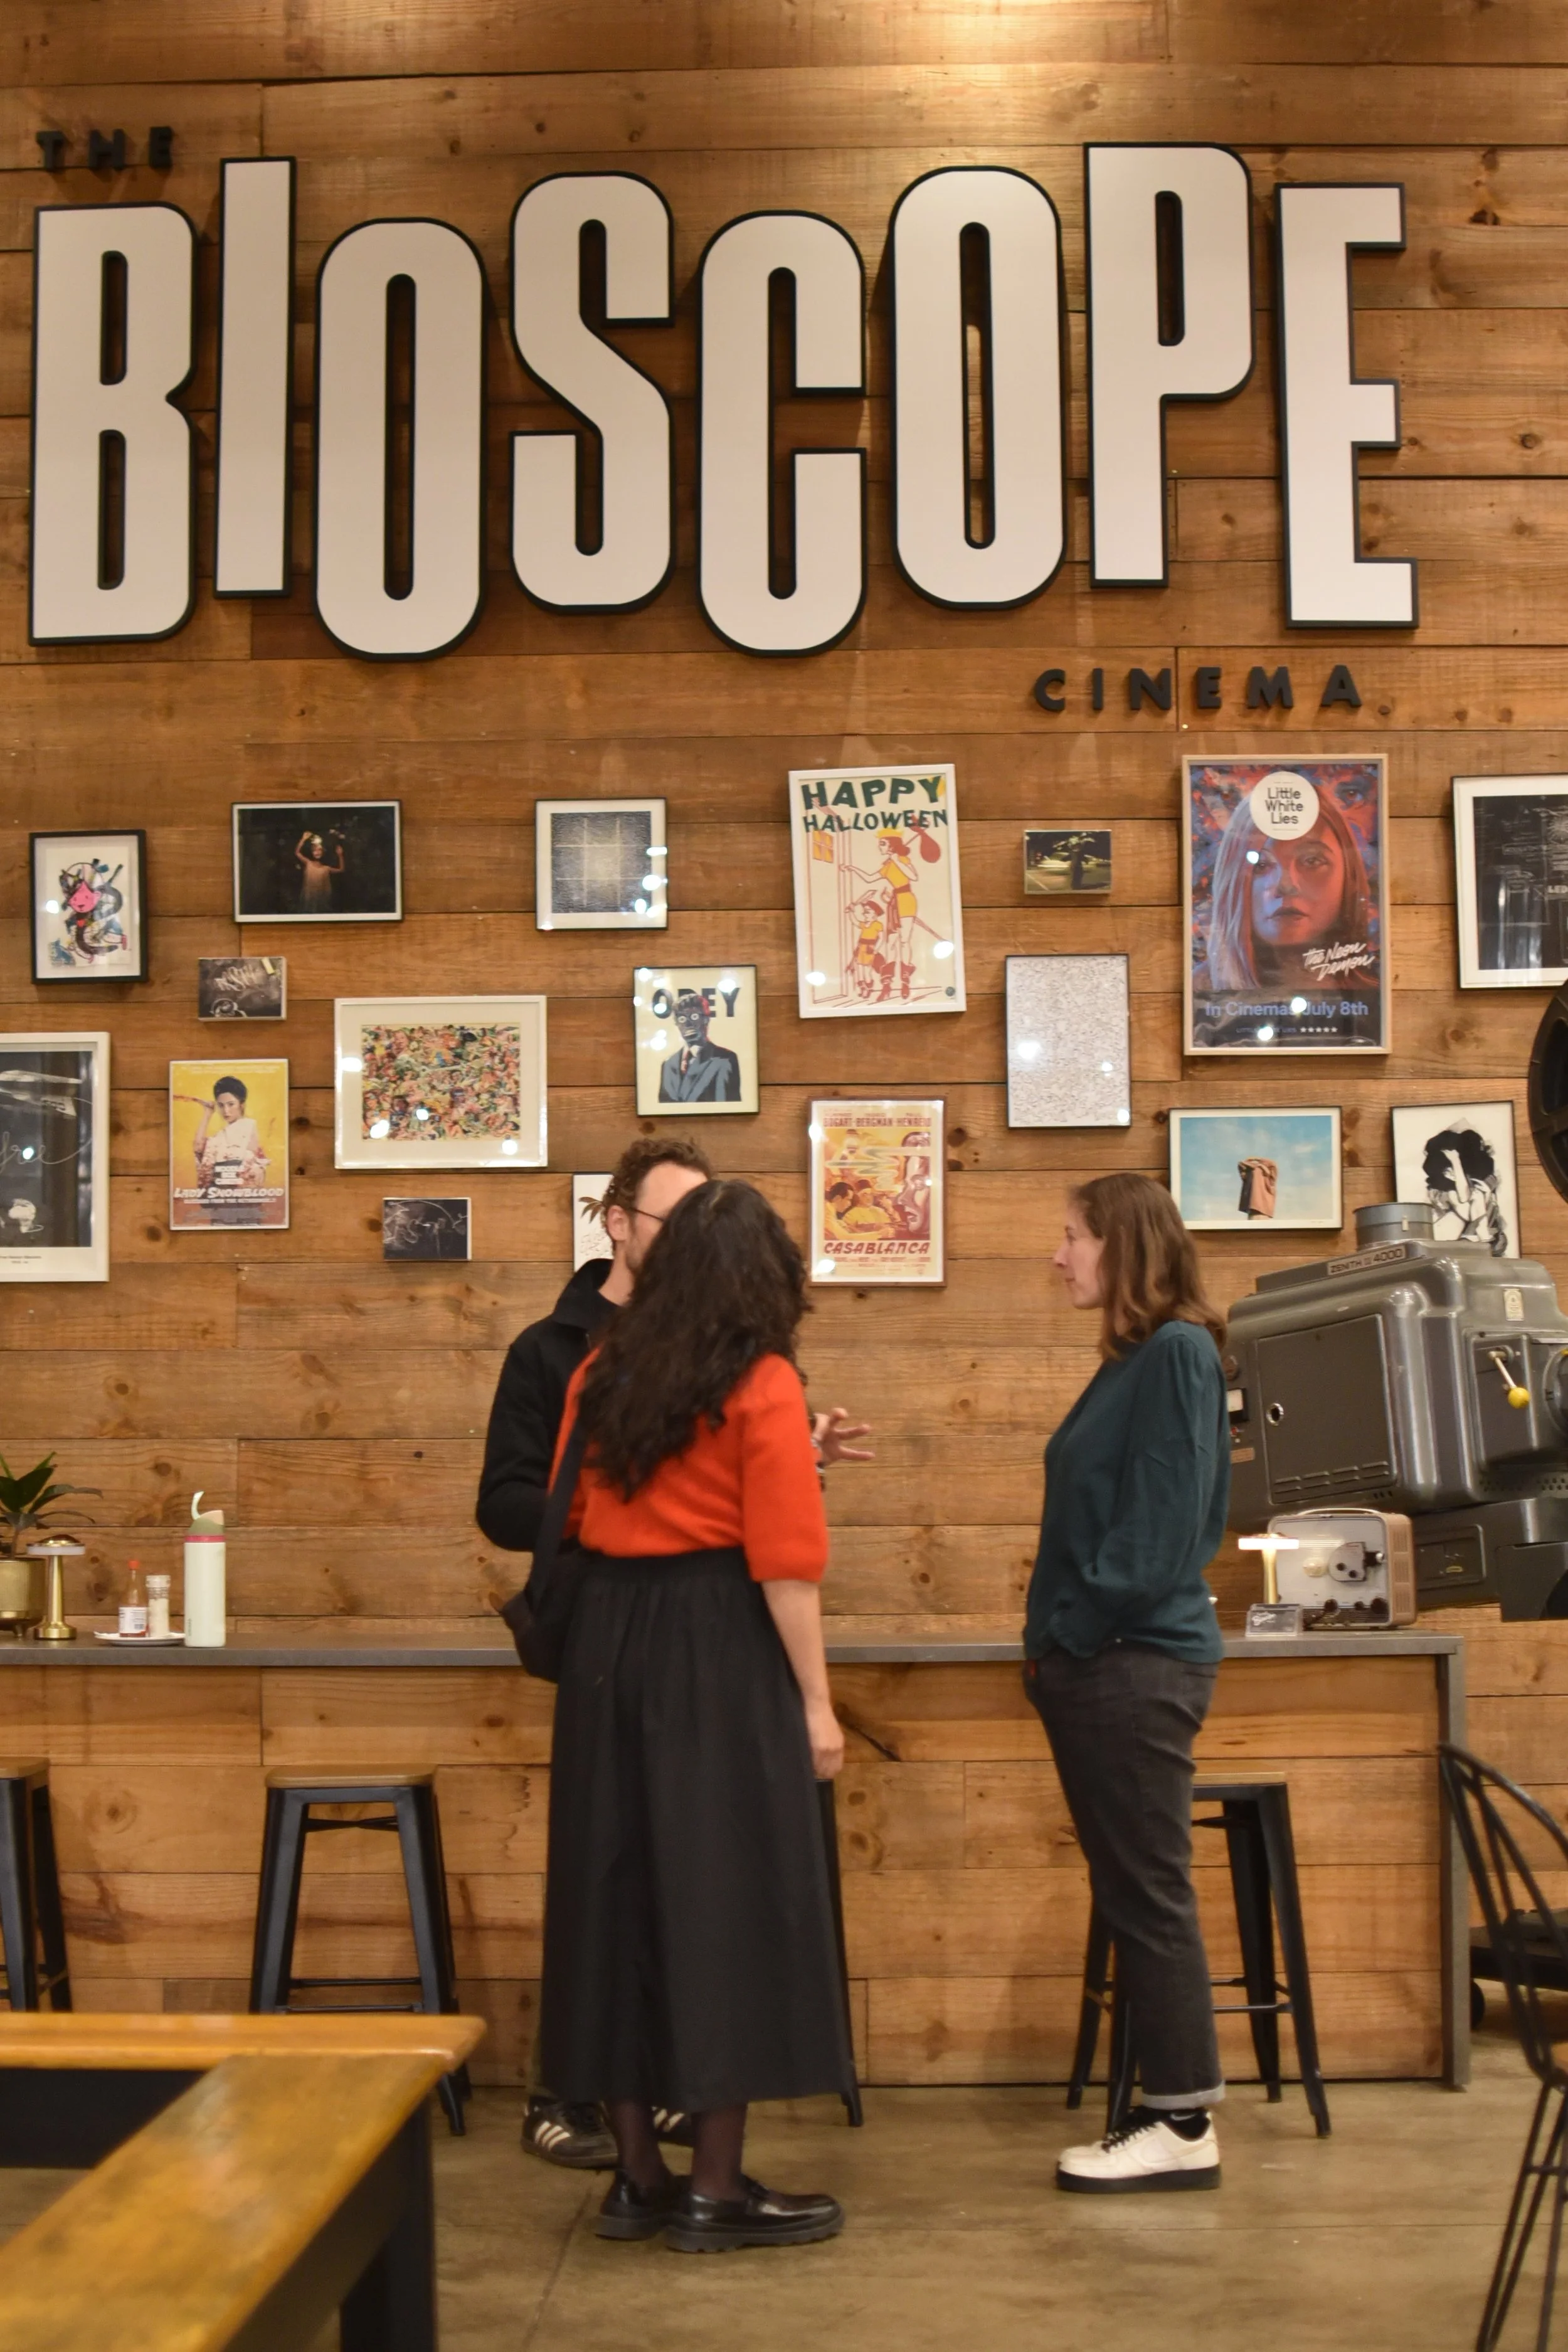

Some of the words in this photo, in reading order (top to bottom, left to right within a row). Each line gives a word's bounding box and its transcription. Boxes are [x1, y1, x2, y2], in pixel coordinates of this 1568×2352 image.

[36, 126, 173, 171] THE
[28, 142, 1420, 662] BIOSCOPE
[1033, 664, 1362, 713] CINEMA
[801, 775, 942, 810] HAPPY
[1267, 787, 1301, 799] Little
[1264, 799, 1304, 812] White
[802, 809, 948, 833] HALLOWEEN
[1271, 812, 1299, 825] Lies
[1205, 1002, 1221, 1016] In
[1340, 1001, 1369, 1016] 8th
[824, 1242, 930, 1254] CASABLANCA
[1374, 1248, 1402, 1262] 4000
